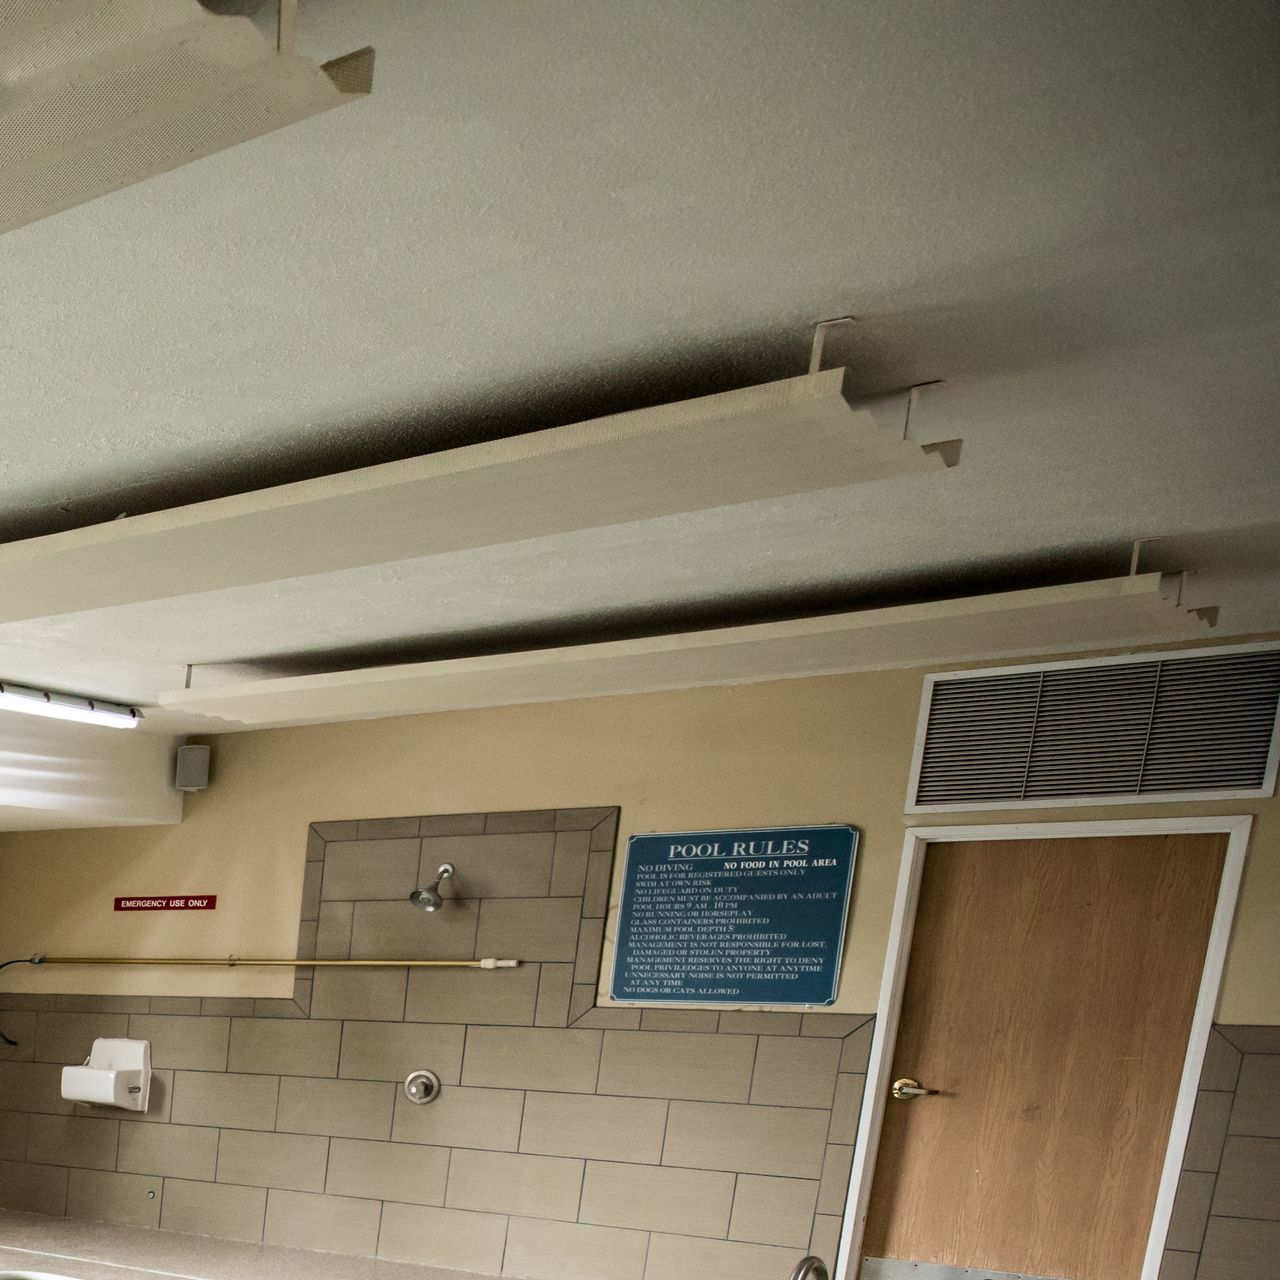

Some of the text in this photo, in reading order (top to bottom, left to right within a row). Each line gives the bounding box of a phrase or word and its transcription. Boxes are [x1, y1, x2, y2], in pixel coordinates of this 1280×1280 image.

[669, 839, 809, 858] POOL RULES
[655, 864, 693, 872] DIVING
[740, 861, 765, 869] FOOD
[812, 859, 837, 867] AREA
[688, 870, 742, 878] REGISTERED
[744, 869, 778, 877] GUESTS
[169, 899, 185, 907] USE
[188, 899, 208, 907] ONLY
